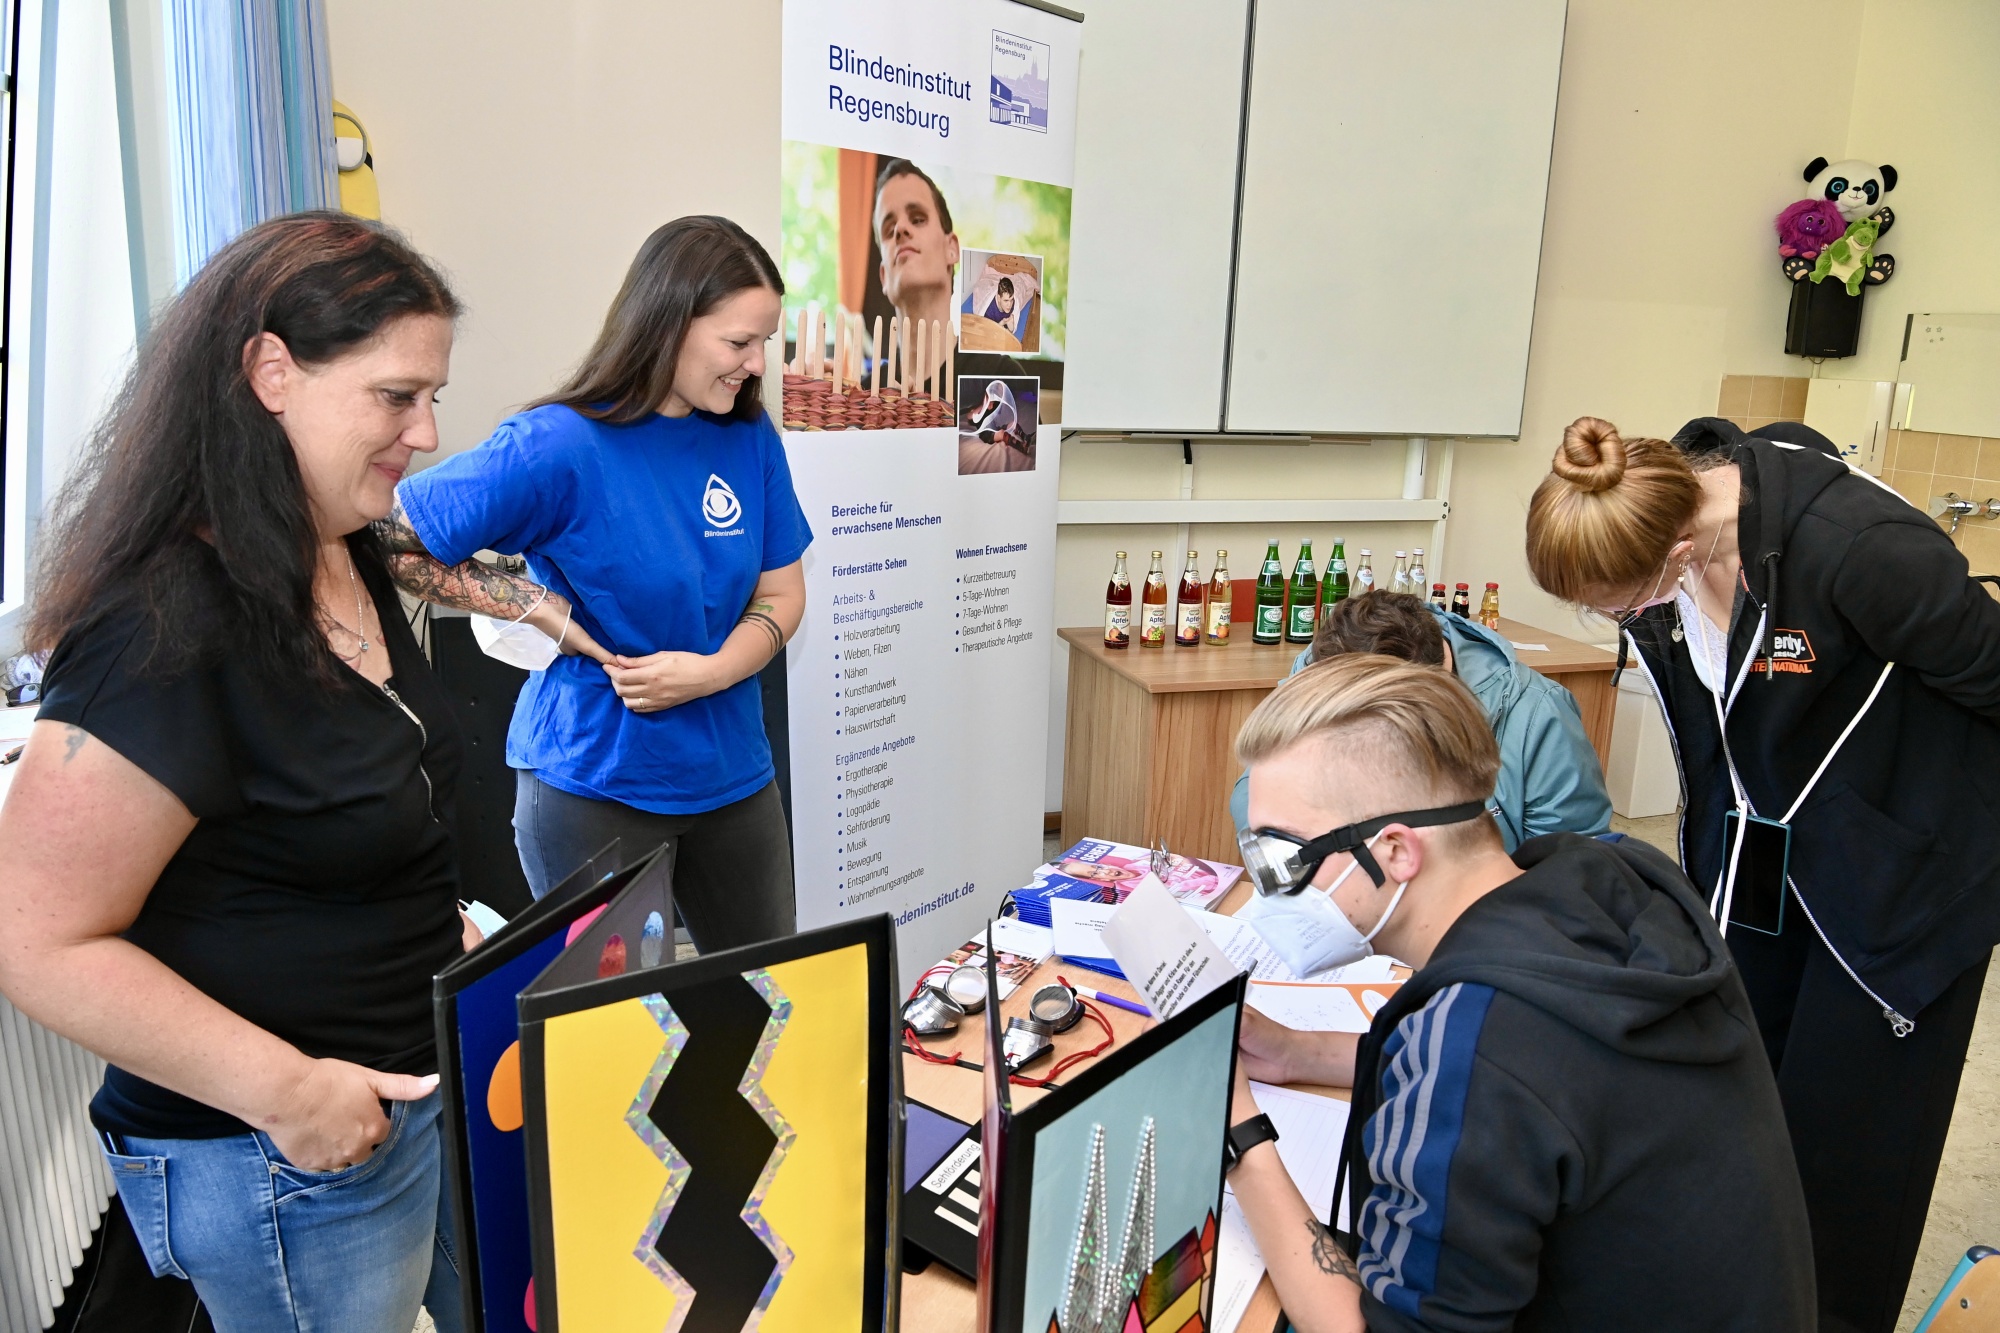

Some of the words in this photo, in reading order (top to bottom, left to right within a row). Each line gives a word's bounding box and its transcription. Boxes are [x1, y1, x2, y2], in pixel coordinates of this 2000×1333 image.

[995, 35, 1033, 52] Blindeninstitut
[995, 45, 1026, 60] Regensburg
[829, 45, 971, 101] Blindeninstitut
[829, 85, 950, 137] Regensburg
[831, 503, 877, 518] Bereiche
[880, 501, 893, 513] für
[704, 528, 745, 538] Blindeninstitut
[831, 521, 893, 536] erwachsene
[895, 514, 942, 529] Menschen
[956, 547, 984, 560] Wohnen
[985, 542, 1028, 556] Erwachsene
[832, 560, 883, 577] Förderstätte
[885, 558, 907, 570] Sehen
[963, 569, 1017, 585] Kurzzeitbetreuung
[832, 592, 867, 607] Arbeits-
[869, 590, 876, 600] &
[962, 586, 1010, 602] 5-Tage-Wohnen
[833, 600, 924, 625] Beschäftigungsbereiche
[962, 603, 1009, 619] 7-Tage-Wohnen
[843, 622, 901, 642] Holzverarbeitung
[962, 622, 995, 637] Gesundheit
[997, 620, 1002, 629] &
[1003, 617, 1023, 630] Pflege
[844, 647, 871, 661] Weben,
[873, 642, 892, 656] Filzen
[962, 636, 1006, 654] Therapeutische
[1006, 631, 1033, 644] Angebote
[844, 667, 868, 680] Nähen
[844, 677, 897, 698] Kunsthandwerk
[844, 693, 906, 717] Papierverarbeitung
[845, 713, 896, 736] Hauswirtschaft
[835, 745, 880, 766] Ergänzende
[882, 735, 916, 753] Angebote
[845, 760, 888, 782] Ergotherapie
[845, 775, 894, 799] Physiotherapie
[846, 798, 881, 818] Logopädie
[846, 812, 891, 836] Sehförderung
[846, 837, 868, 854] Musik
[847, 850, 882, 872] Bewegung
[847, 864, 889, 889] Entspannung
[847, 866, 924, 906] Wahrnehmungsangebote
[930, 1143, 981, 1188] Sehförderung
